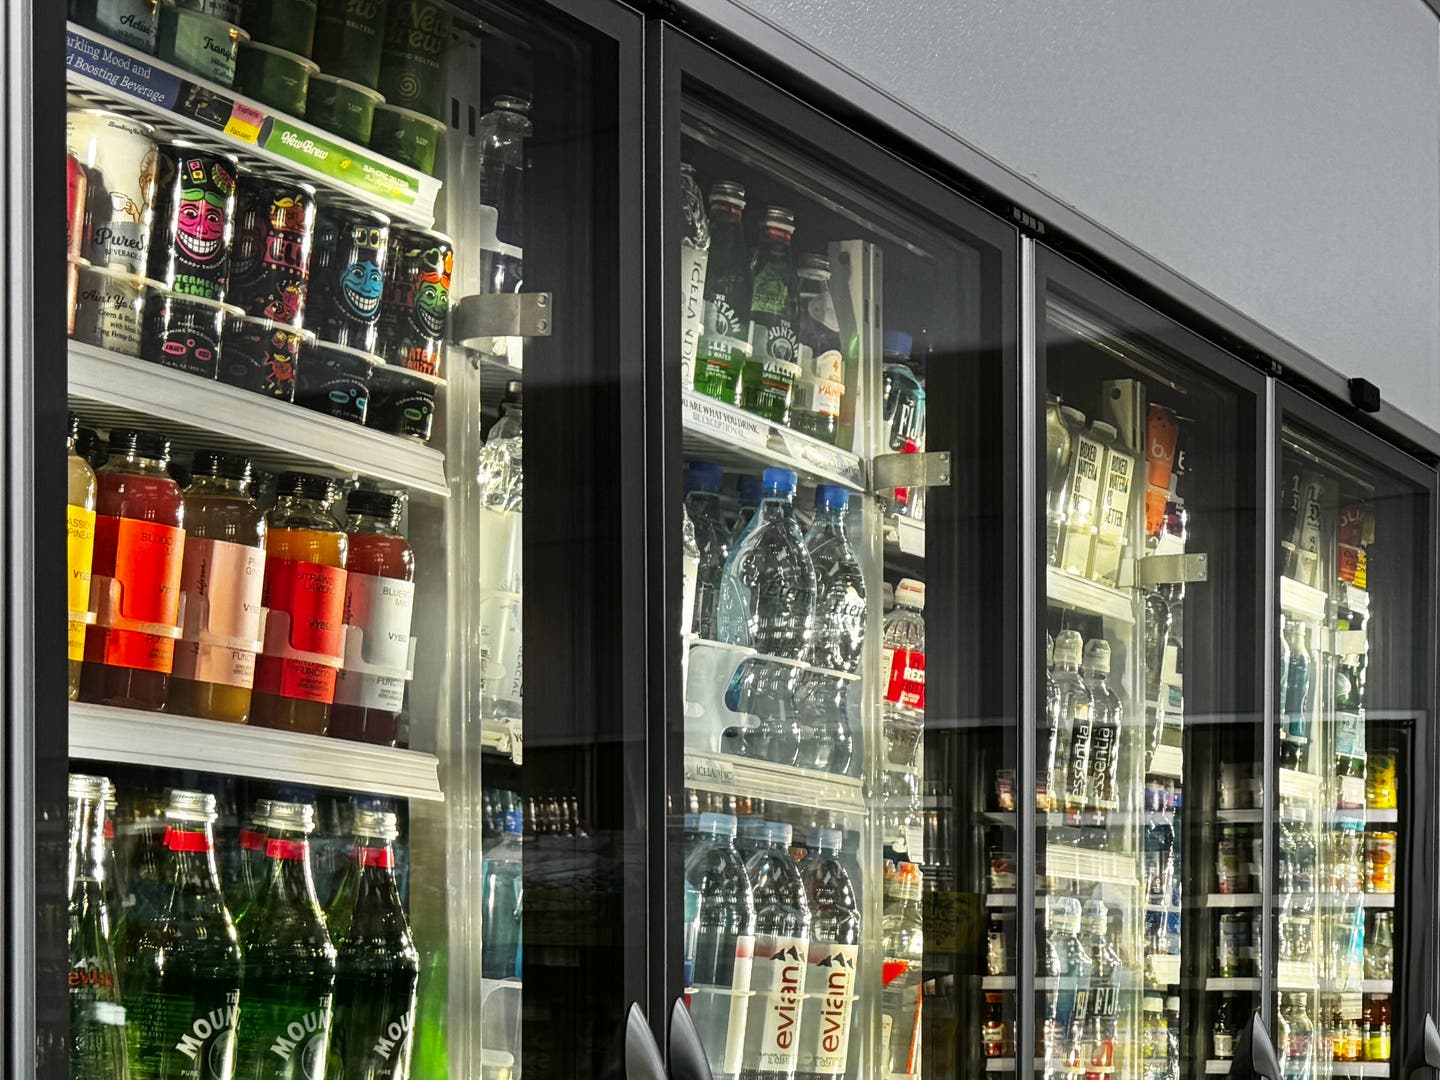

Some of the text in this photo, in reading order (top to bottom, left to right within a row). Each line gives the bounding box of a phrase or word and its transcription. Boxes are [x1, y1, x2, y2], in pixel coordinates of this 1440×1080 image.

[102, 49, 131, 71] Mood
[132, 63, 151, 79] and
[74, 56, 165, 103] Boosting Beverage
[780, 320, 791, 328] THE
[763, 361, 795, 379] VALLEY
[689, 400, 702, 412] ARE
[702, 404, 723, 418] WHAT
[722, 411, 739, 426] YOU
[1079, 438, 1098, 460] BOXED
[1110, 453, 1128, 474] BOXED
[1106, 509, 1123, 528] ETTER
[1072, 724, 1089, 798] essentia
[774, 965, 800, 1050] evian
[819, 970, 846, 1053] evian
